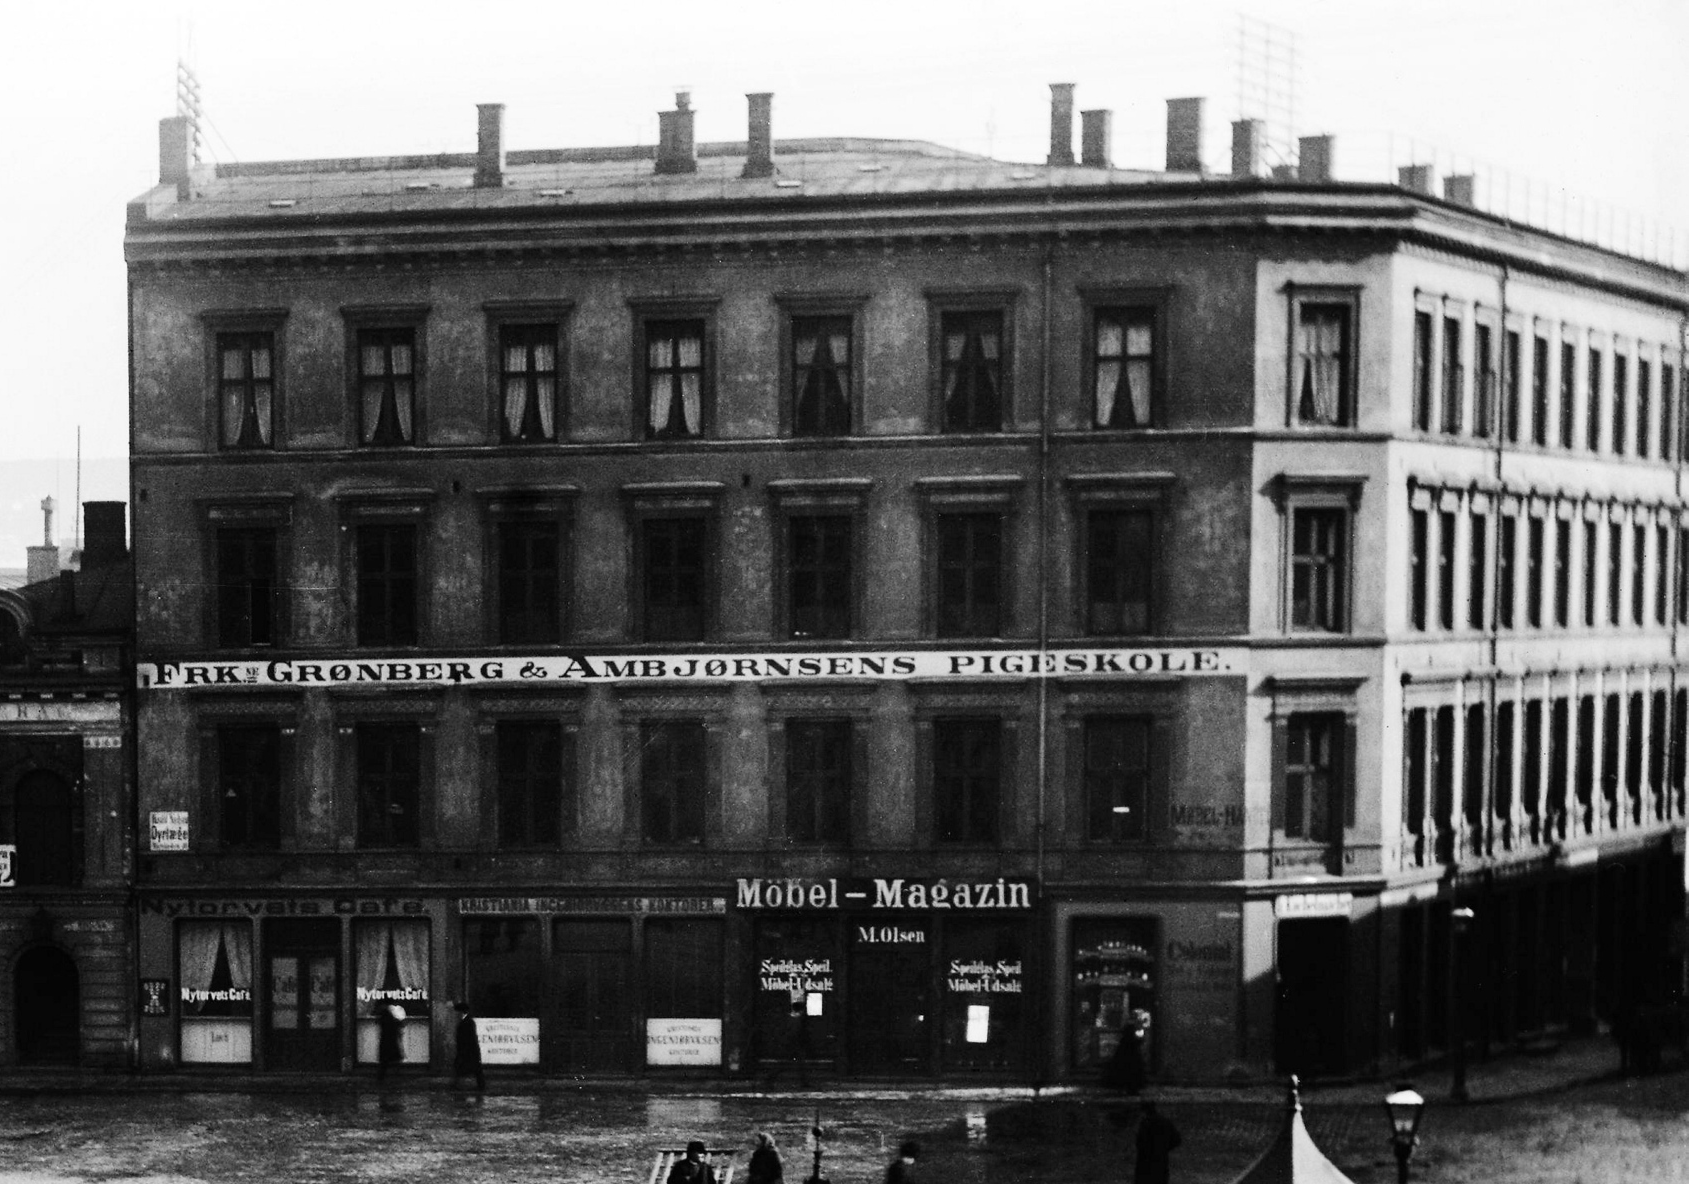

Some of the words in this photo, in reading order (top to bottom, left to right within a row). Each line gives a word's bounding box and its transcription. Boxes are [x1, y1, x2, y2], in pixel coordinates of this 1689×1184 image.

[266, 658, 504, 683] GRØNBERG
[519, 660, 549, 679] &
[560, 653, 917, 679] AMBJØRNSENS
[949, 649, 1233, 676] PIGESKOLE.
[872, 878, 1032, 909] Magazin
